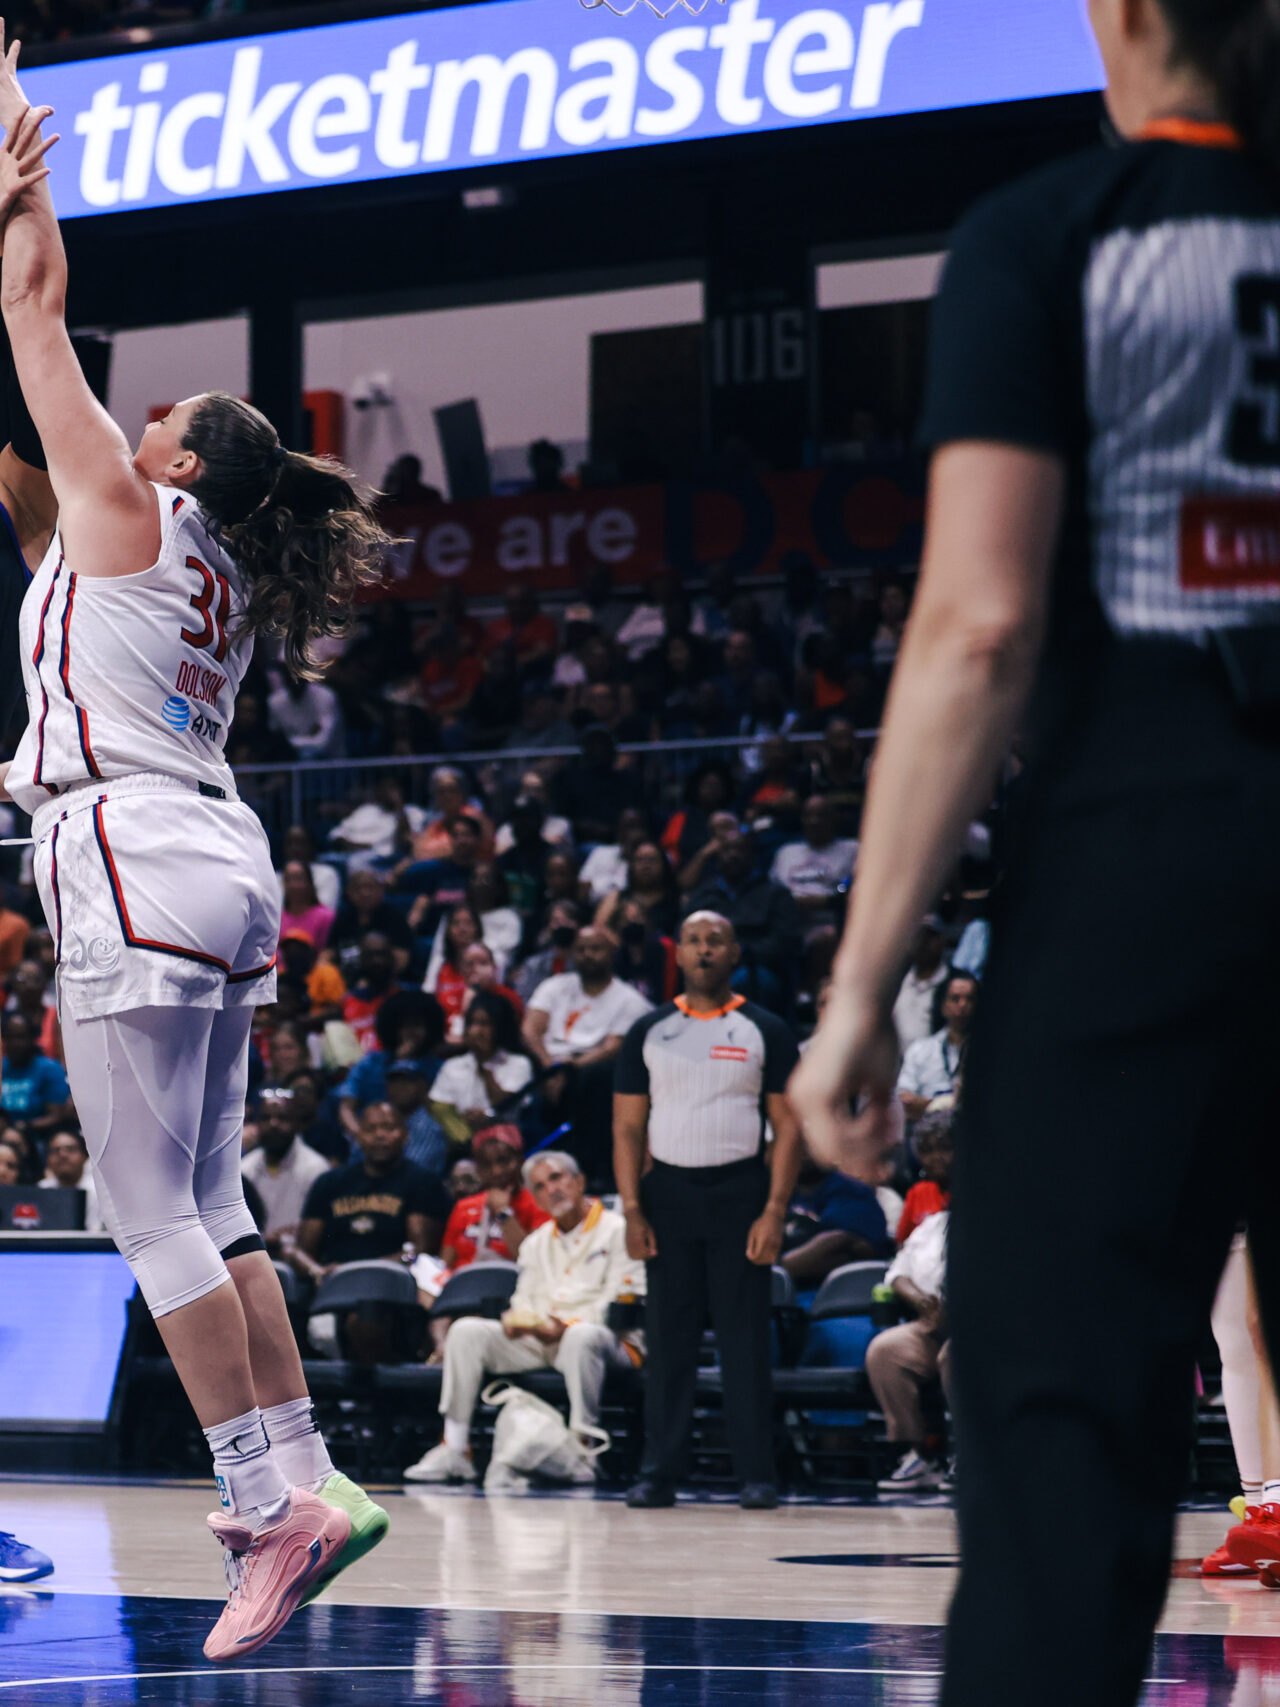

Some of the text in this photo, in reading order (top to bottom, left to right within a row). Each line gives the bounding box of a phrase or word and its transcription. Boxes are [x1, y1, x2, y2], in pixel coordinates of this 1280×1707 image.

[74, 0, 924, 207] ticketmaster
[712, 308, 804, 386] 106
[497, 507, 638, 571] are
[180, 555, 230, 664] 31
[176, 660, 228, 708] DOLSON
